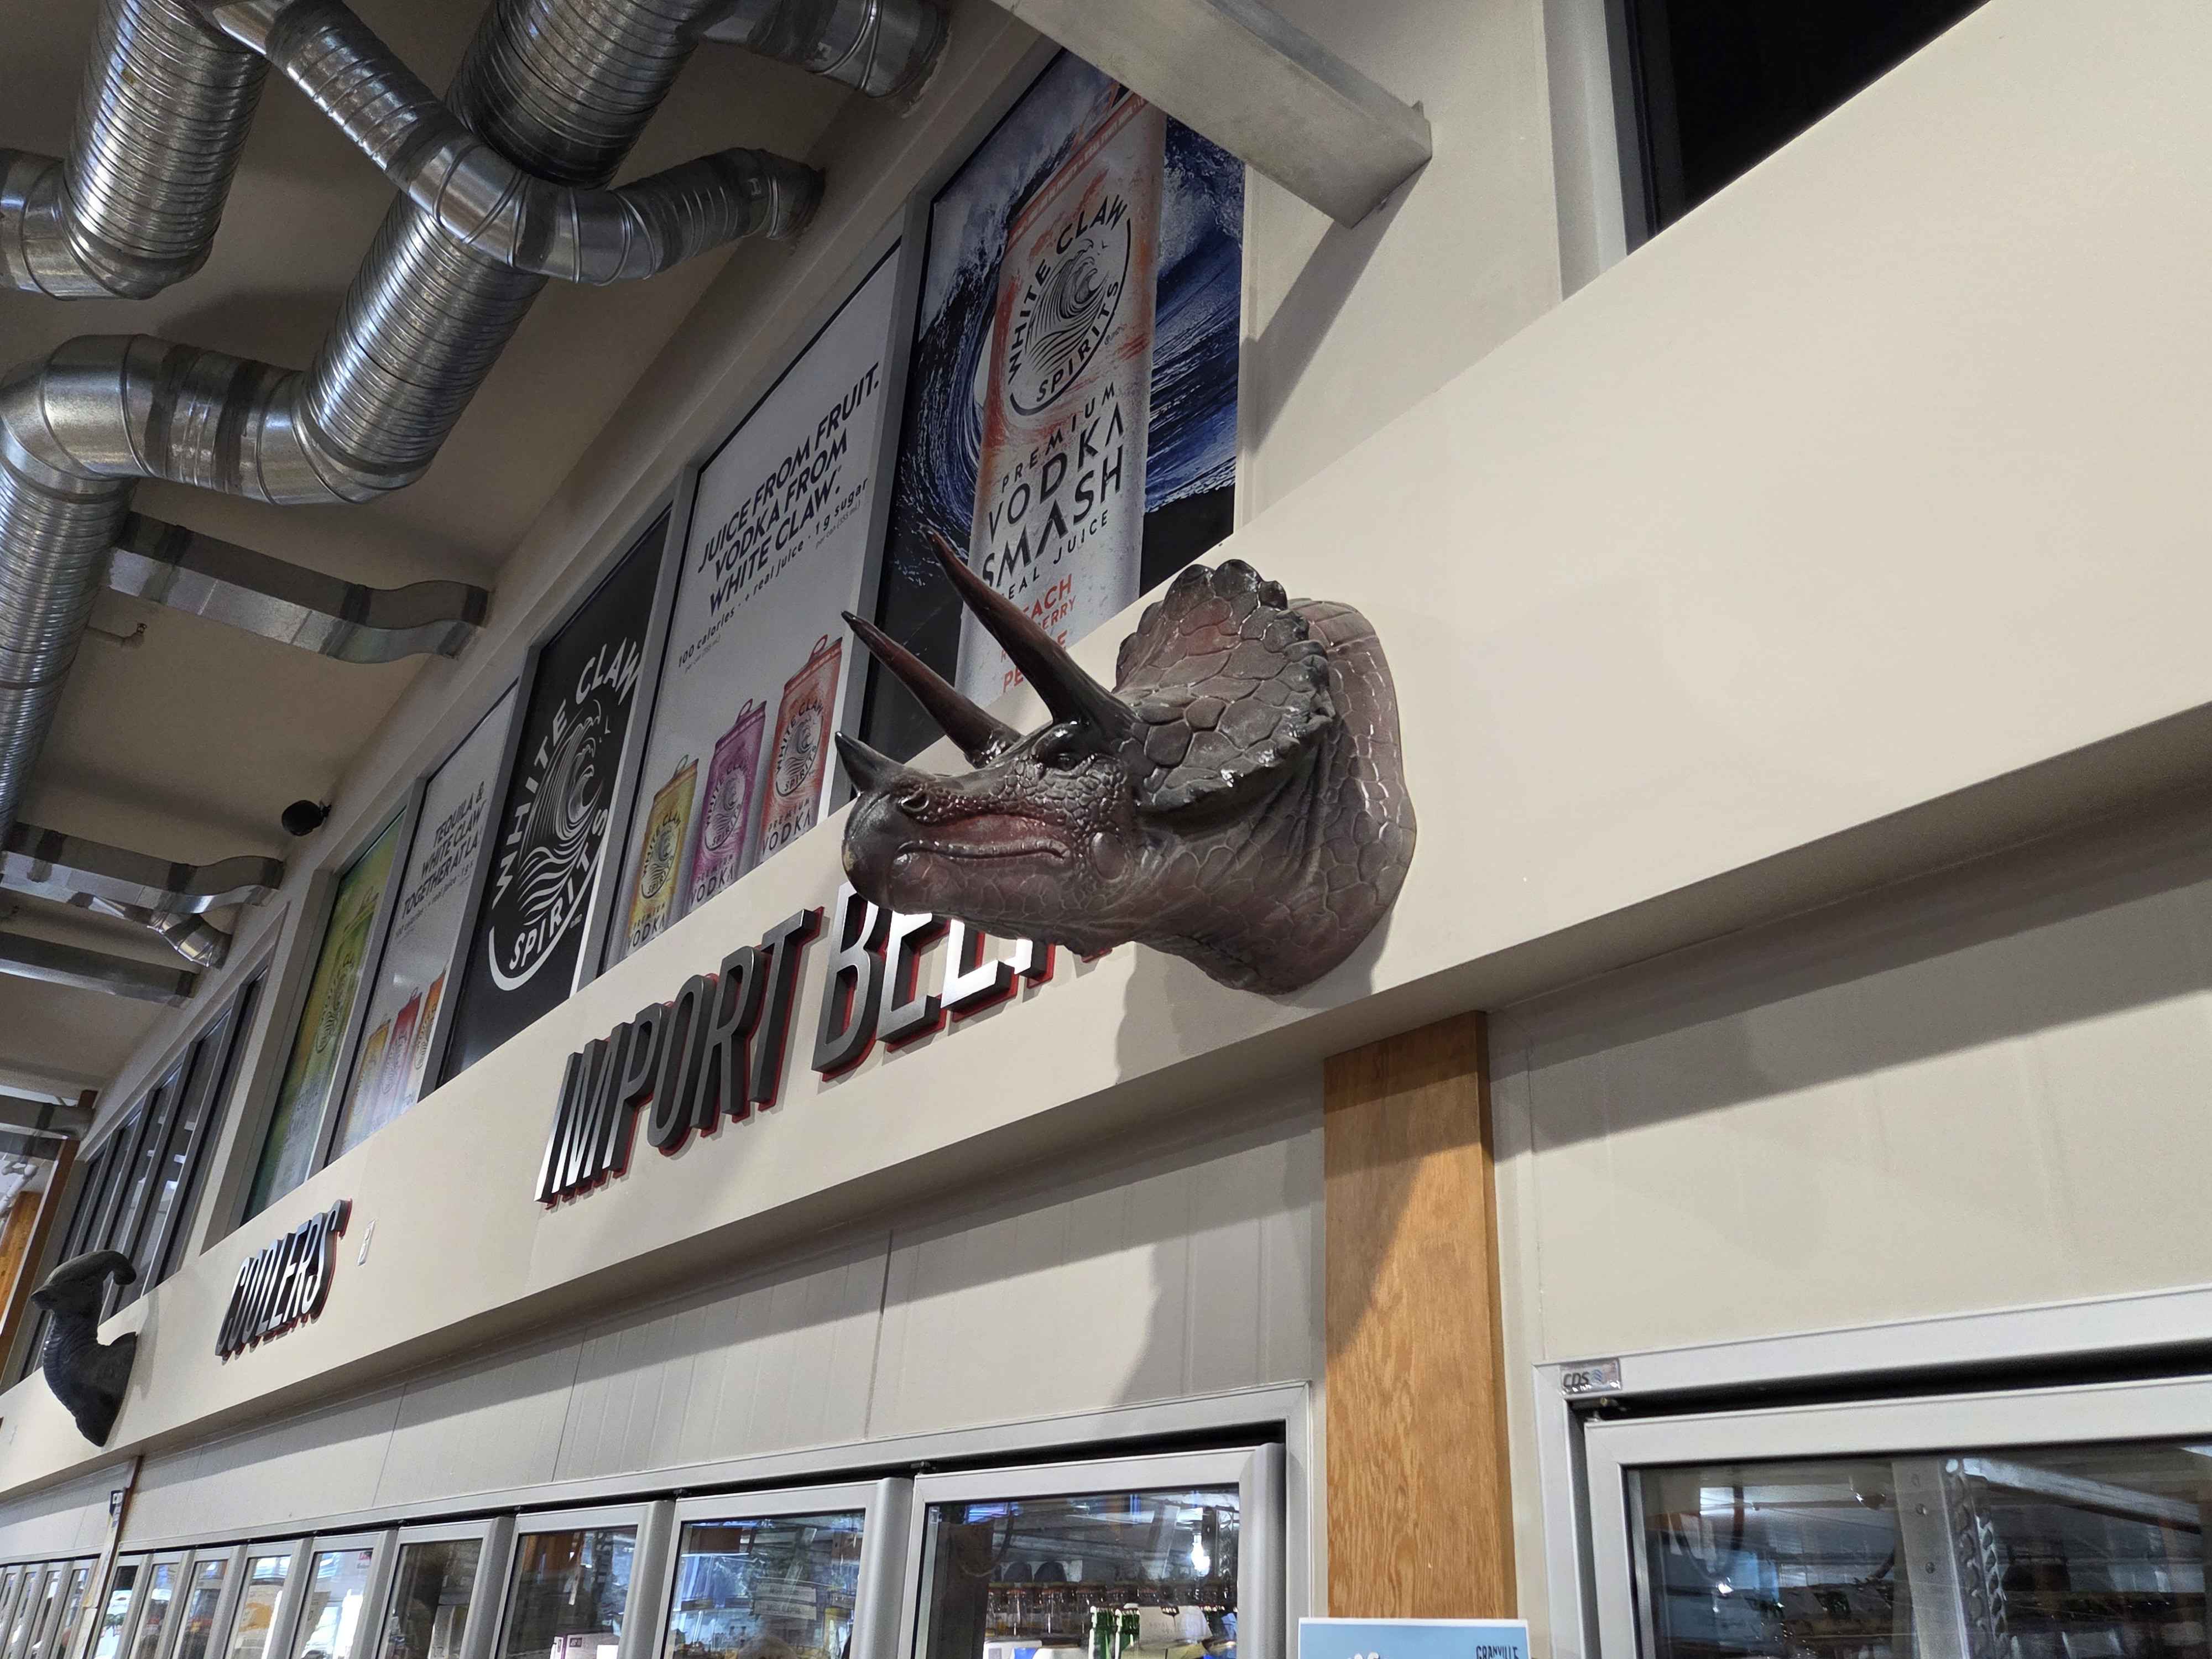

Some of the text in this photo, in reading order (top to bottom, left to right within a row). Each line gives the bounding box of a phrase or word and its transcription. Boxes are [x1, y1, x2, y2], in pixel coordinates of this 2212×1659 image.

[1008, 258, 1052, 384] WHITE
[1057, 195, 1128, 255] CLAW
[1036, 281, 1119, 403] SPIRITS
[698, 499, 752, 574] JUICE
[753, 435, 811, 514] FROM
[816, 362, 879, 450] FRUIT.
[989, 402, 1124, 544] VODKA
[1001, 382, 1115, 493] PREMIUM
[716, 429, 848, 583] VODKA FROM
[982, 445, 1122, 588] SMASH
[1002, 509, 1108, 601] EAL JUICE
[679, 644, 695, 667] 100
[696, 607, 735, 650] calories
[753, 572, 776, 599] real
[775, 541, 805, 578] juice
[834, 477, 868, 517] sugar
[709, 538, 769, 617] WHITE
[1023, 573, 1072, 620] ACH
[492, 637, 643, 910] WHITE CLAW
[776, 698, 823, 775] WHITE CLAW
[421, 834, 454, 879] WHITE
[453, 799, 487, 847] CLAW
[434, 792, 474, 848] TEQUILA
[761, 809, 813, 855] VODKA
[768, 799, 810, 832] PREMIUM
[401, 856, 452, 919] TOGETHER
[509, 808, 608, 970] SPIRITS
[690, 864, 734, 906] VODKA
[534, 907, 822, 1209] IMPORT
[215, 1198, 352, 1360] COOLERS
[1563, 1371, 1590, 1387] CDS
